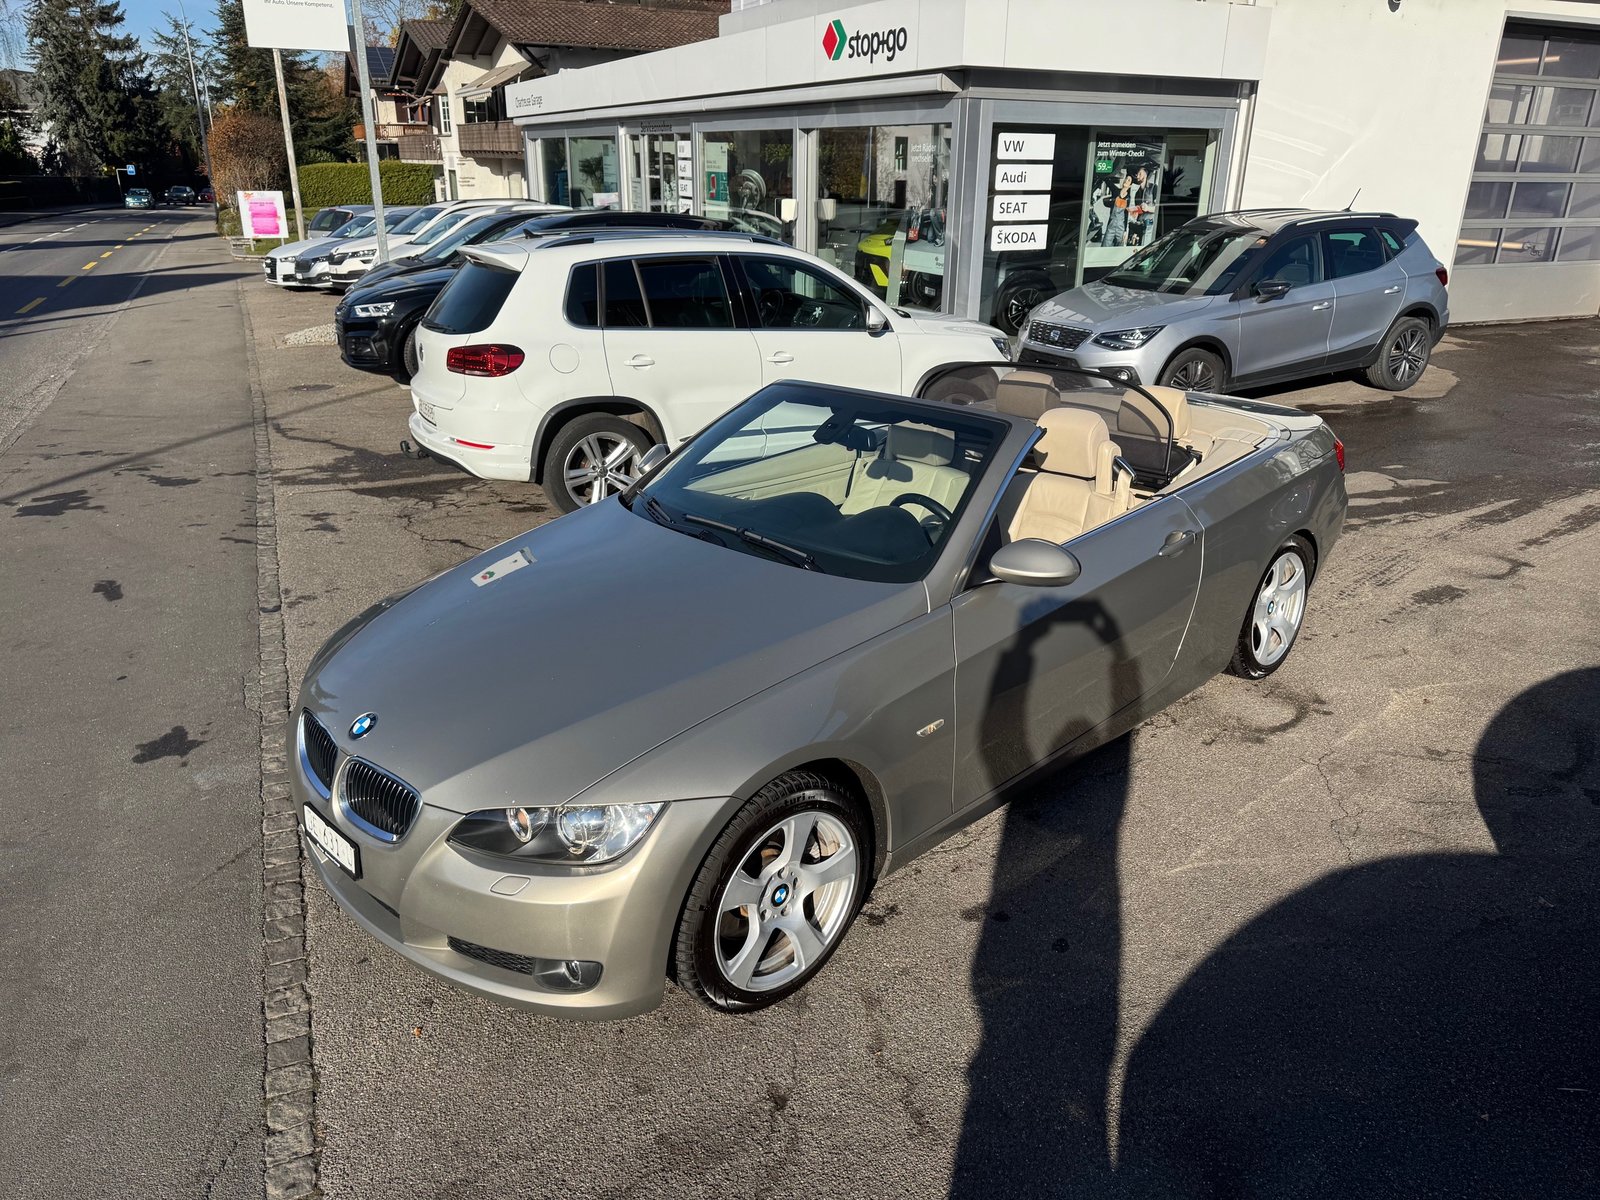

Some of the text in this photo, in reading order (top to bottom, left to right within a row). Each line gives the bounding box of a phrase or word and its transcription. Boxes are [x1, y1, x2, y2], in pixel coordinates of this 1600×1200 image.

[848, 26, 908, 64] stop+go
[1003, 140, 1025, 152] VW
[1001, 171, 1027, 183] Audi
[999, 202, 1027, 214] SEAT
[997, 229, 1037, 244] ŠKODA
